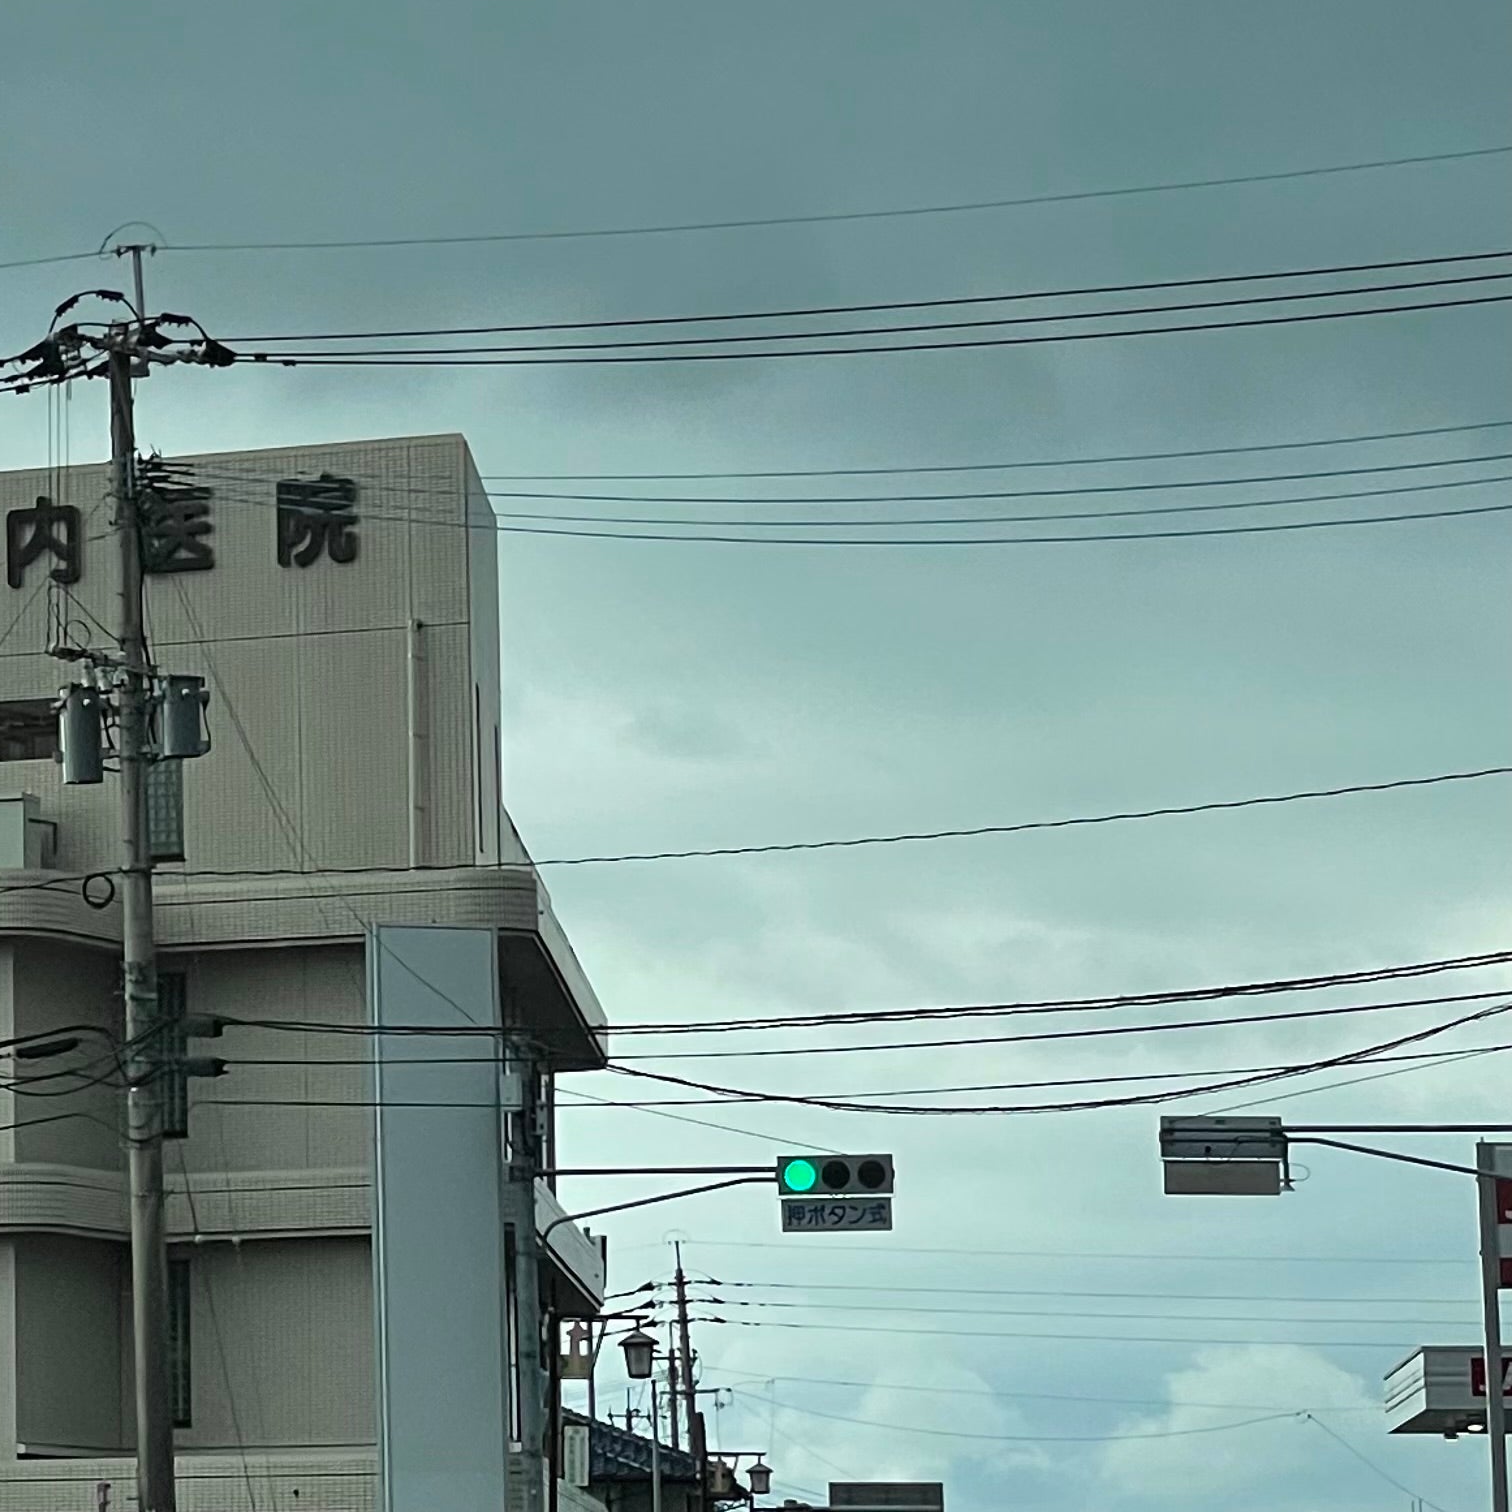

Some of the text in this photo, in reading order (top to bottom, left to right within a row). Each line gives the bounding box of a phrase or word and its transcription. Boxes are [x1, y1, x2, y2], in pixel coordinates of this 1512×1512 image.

[788, 1202, 887, 1226] 押ボタン式
